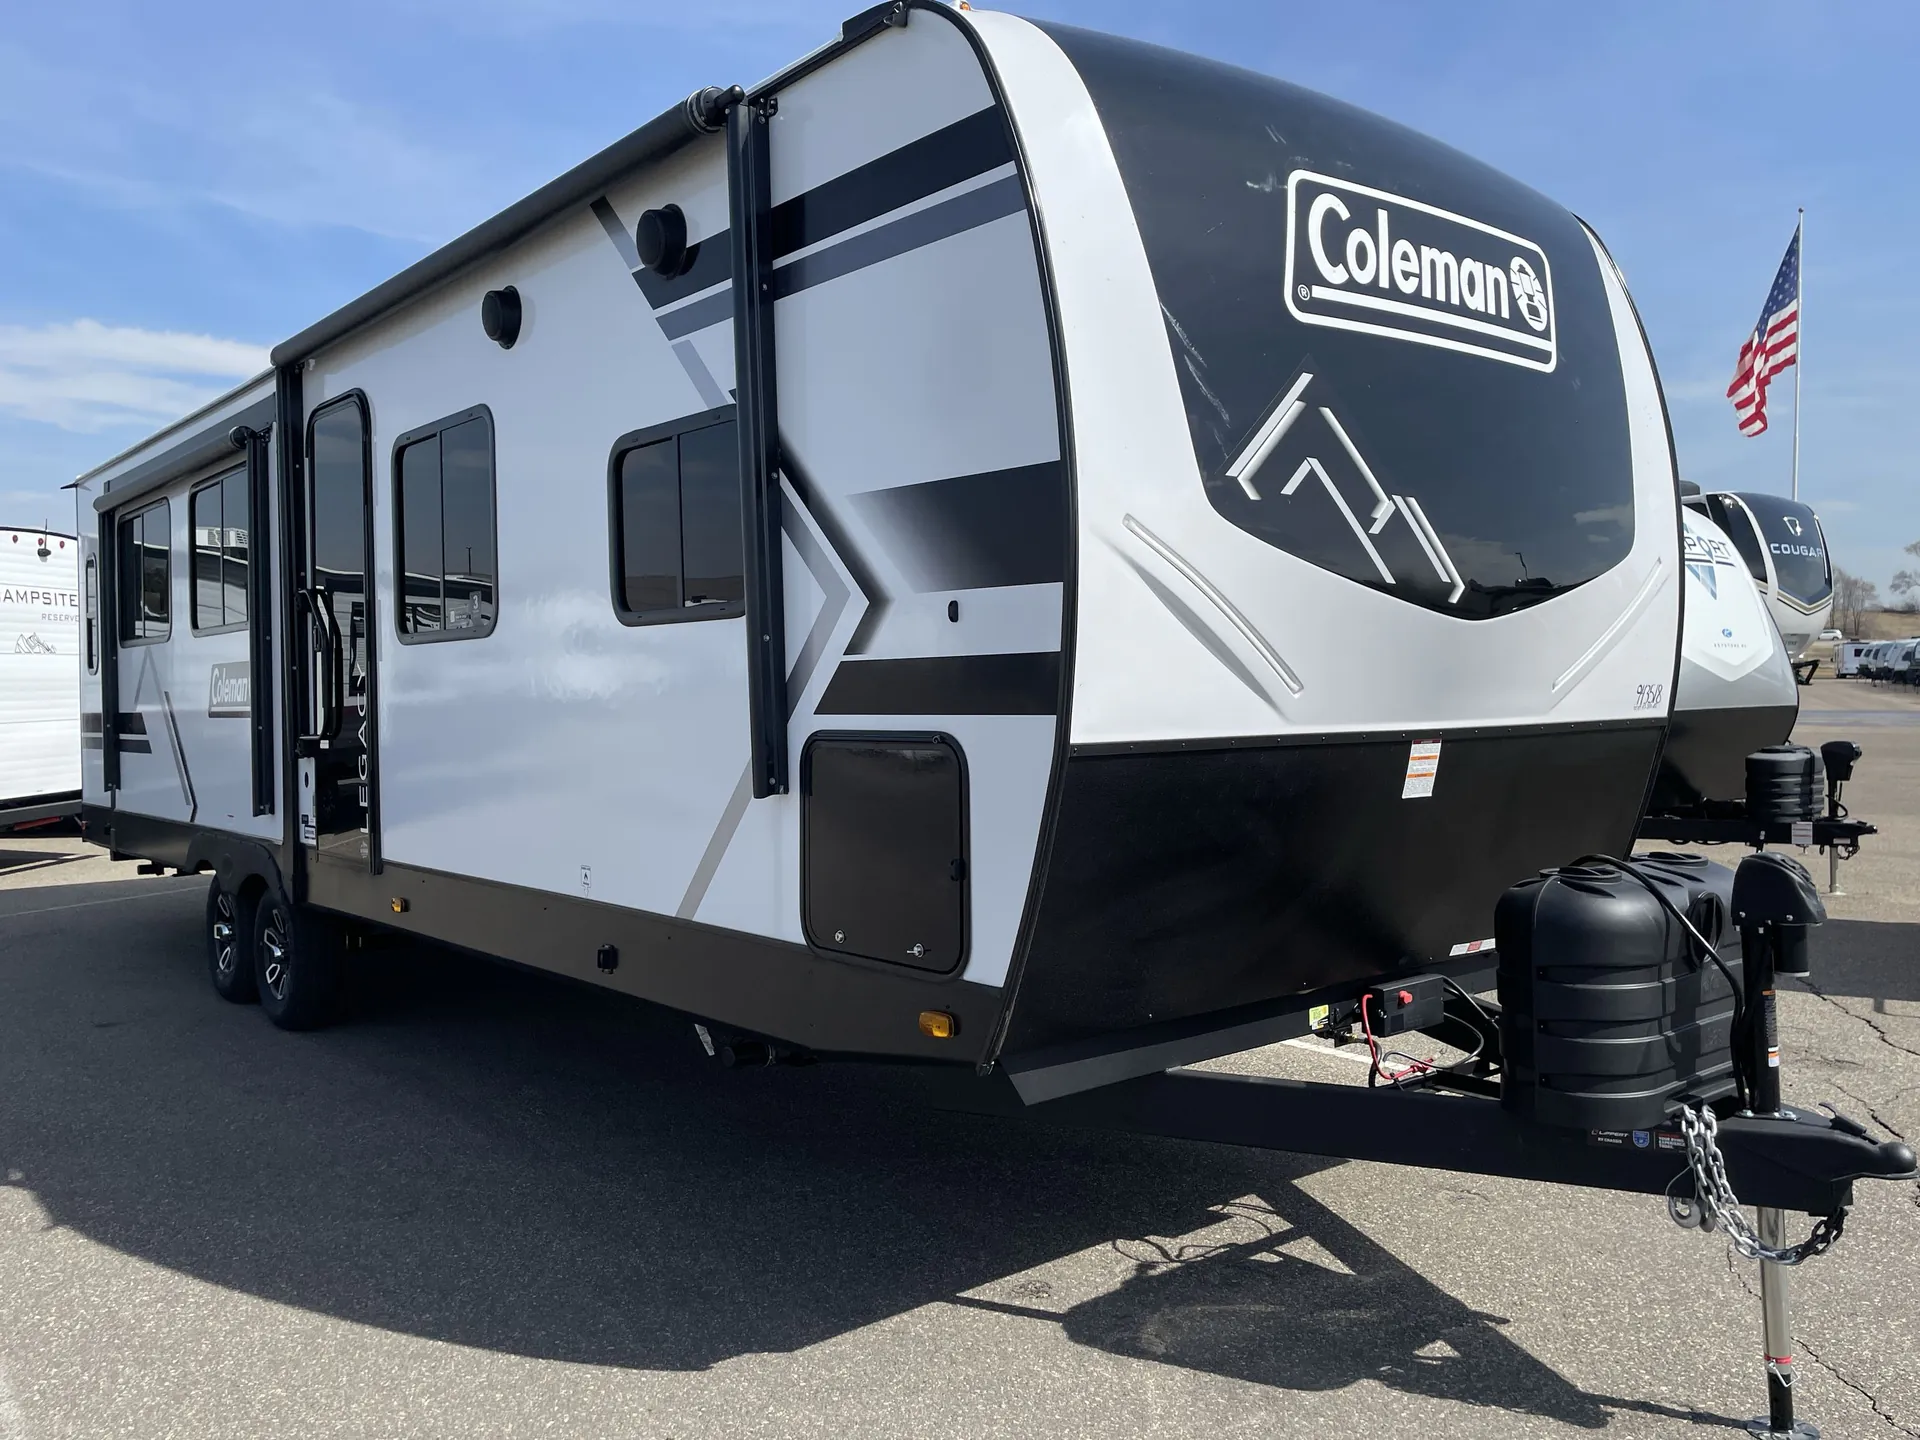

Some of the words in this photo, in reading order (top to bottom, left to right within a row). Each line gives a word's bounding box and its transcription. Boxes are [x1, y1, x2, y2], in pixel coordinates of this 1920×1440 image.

[1308, 192, 1510, 319] Coleman
[1683, 536, 1731, 559] PORT
[1770, 543, 1824, 558] COUGAR
[0, 588, 78, 607] AMPSITE
[41, 613, 79, 622] RESERVE
[211, 667, 248, 705] Coleman
[356, 662, 369, 834] LEGACY
